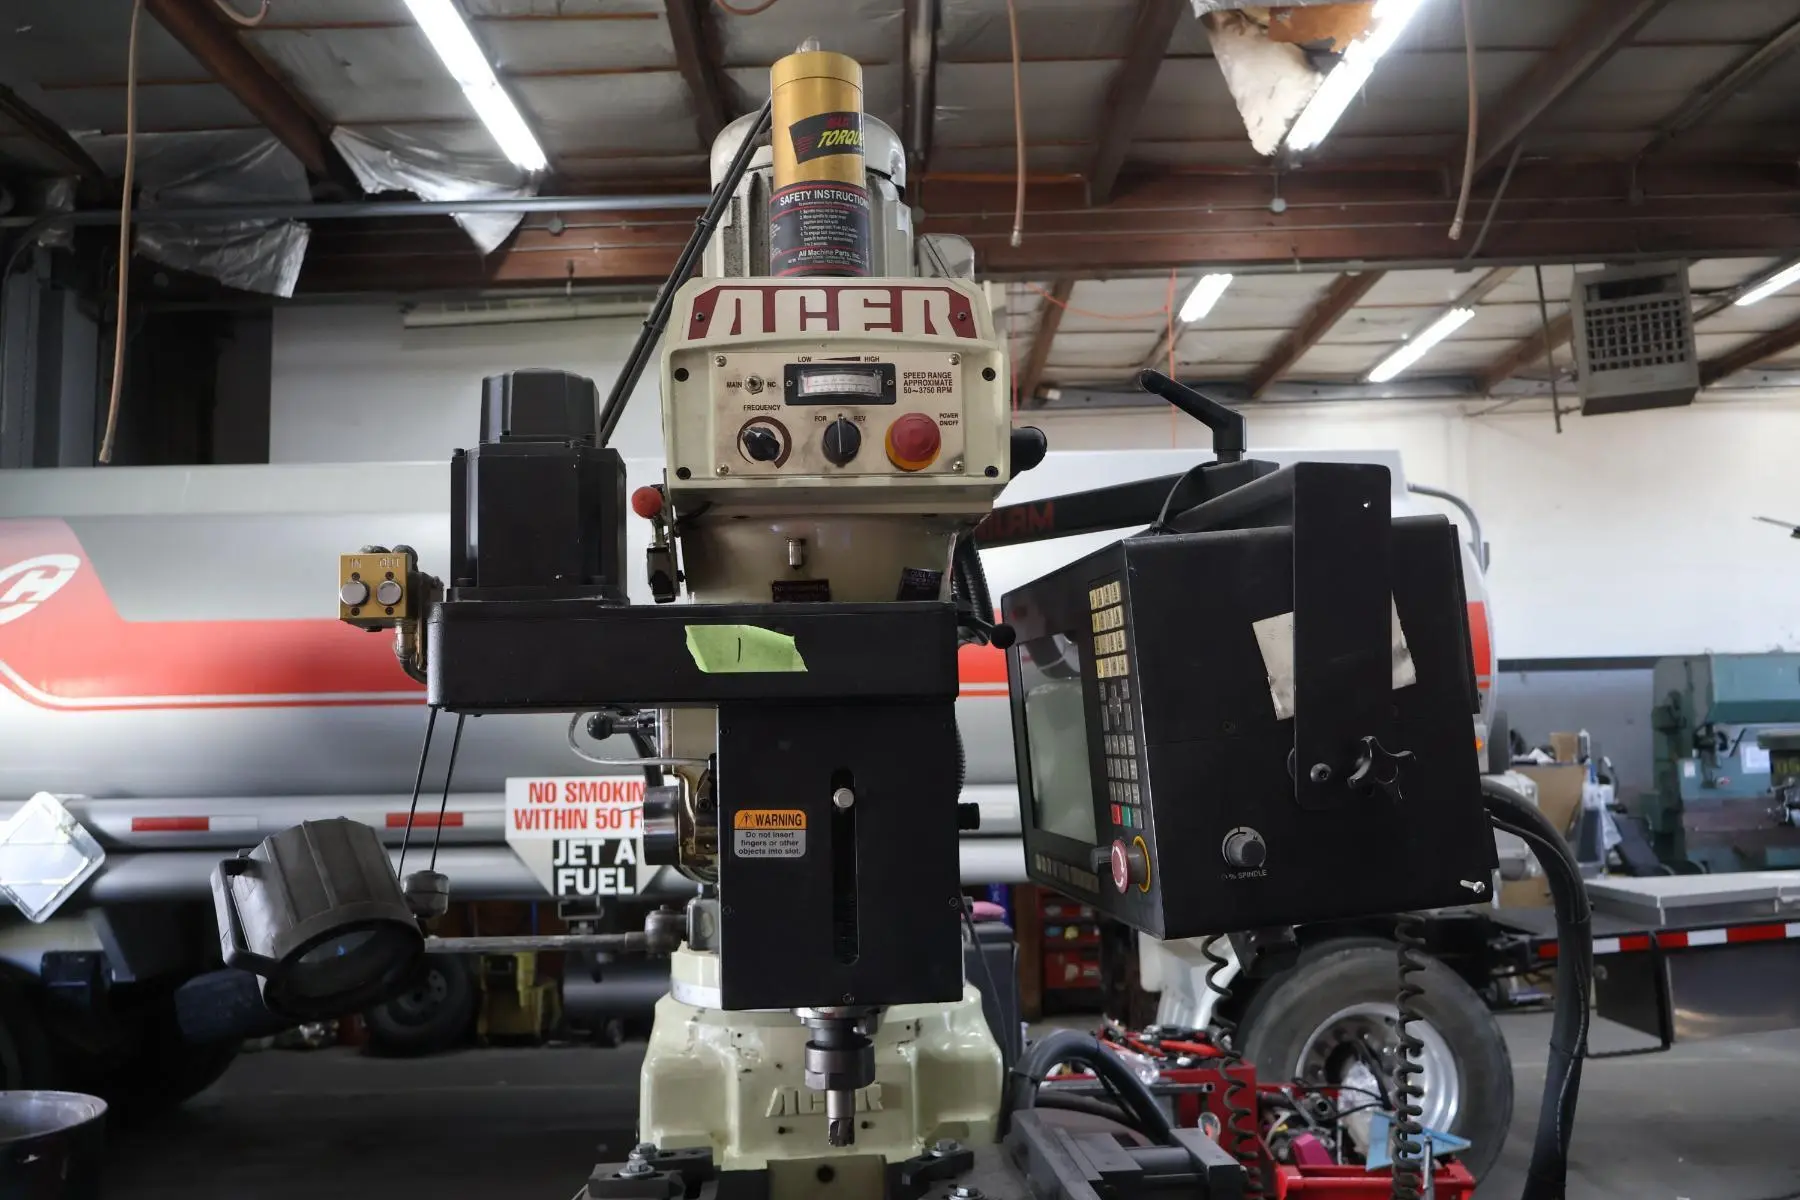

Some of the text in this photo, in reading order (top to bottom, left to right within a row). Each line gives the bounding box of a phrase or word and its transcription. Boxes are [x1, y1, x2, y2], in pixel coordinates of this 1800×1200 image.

[780, 190, 811, 206] SAFETY
[705, 289, 960, 338] ACER
[903, 371, 952, 379] SPEED RANGE
[903, 379, 953, 387] APPROXIMATE
[936, 386, 953, 394] RPM
[528, 781, 645, 803] NO SMOKIN
[513, 807, 643, 830] WITHIN 50 F
[755, 813, 802, 827] WARNING
[740, 840, 767, 848] fingers
[779, 839, 800, 847] other
[553, 839, 636, 866] JET A
[738, 848, 766, 856] objects
[557, 868, 634, 895] FUEL
[1238, 869, 1268, 879] SPINDLE
[765, 1084, 884, 1118] ACR
